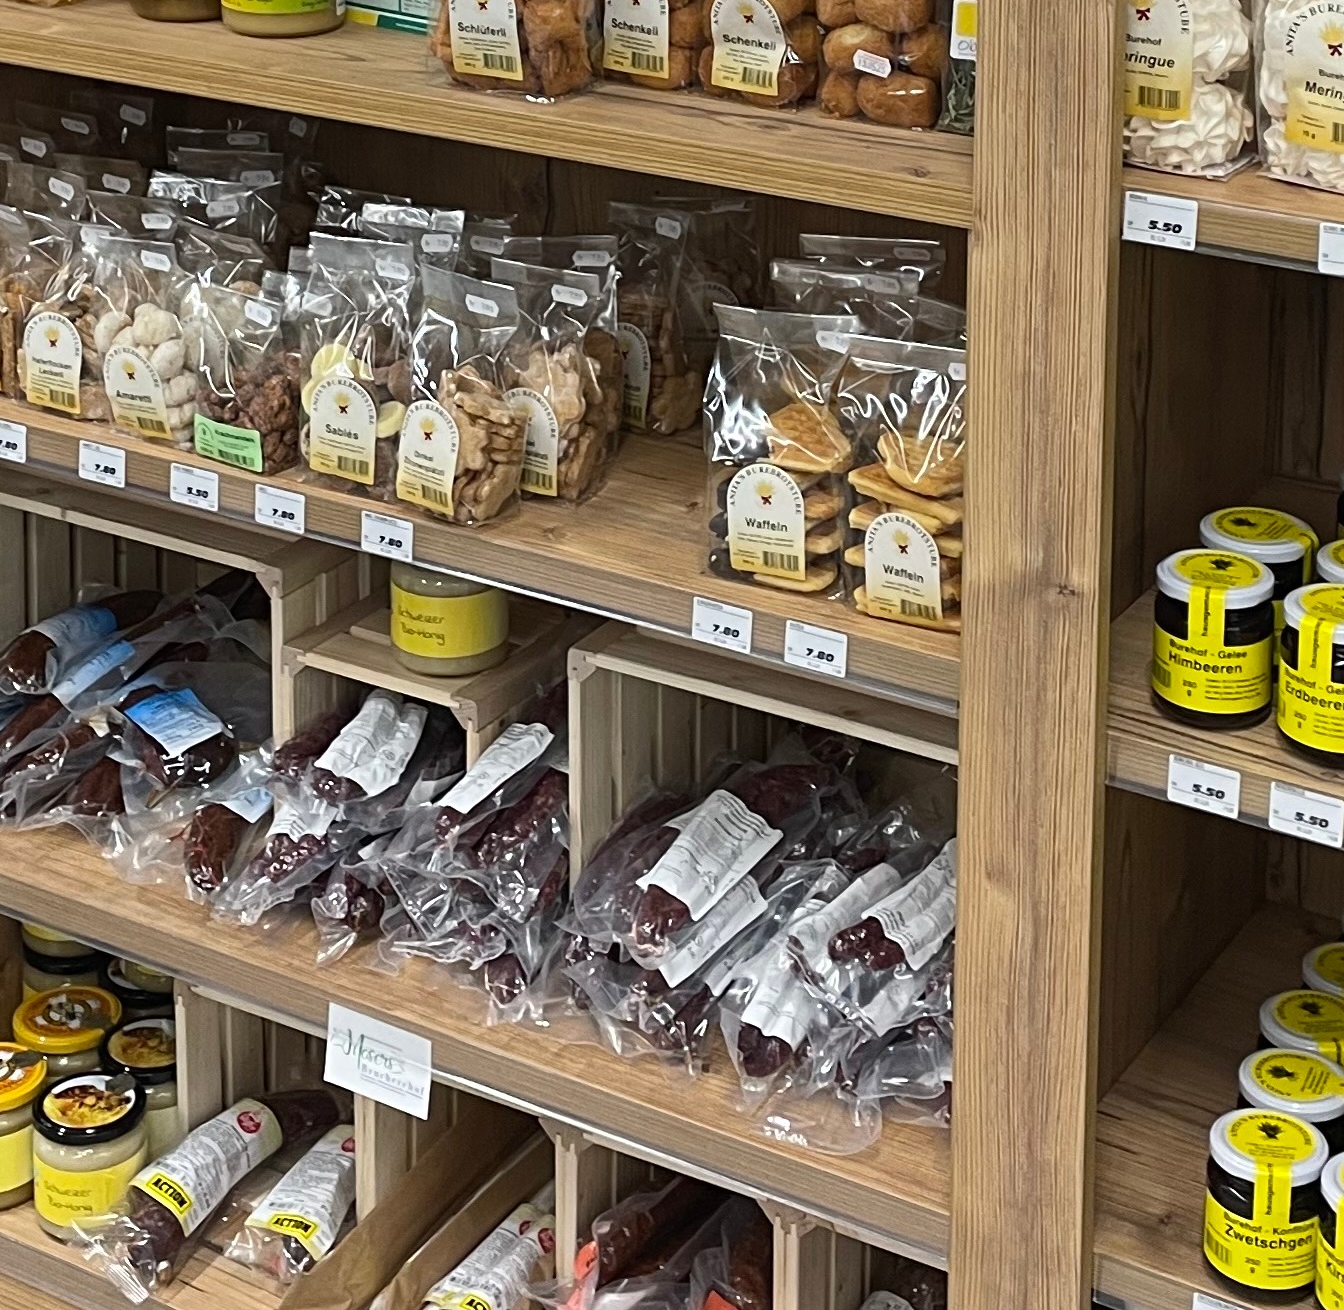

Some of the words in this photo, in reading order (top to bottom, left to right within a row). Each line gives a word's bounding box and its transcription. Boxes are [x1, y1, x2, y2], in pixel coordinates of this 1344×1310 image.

[1125, 51, 1176, 69] ringue
[1147, 220, 1183, 234] 5.50
[744, 517, 788, 533] Waffeln
[712, 623, 741, 638] 7.80
[806, 647, 835, 663] 7.80
[1167, 650, 1244, 676] Himbeeren
[1192, 783, 1226, 801] 5.50
[1294, 811, 1330, 828] 5.50
[150, 1177, 190, 1215] ACTION
[1224, 1222, 1313, 1252] Zwetschgen
